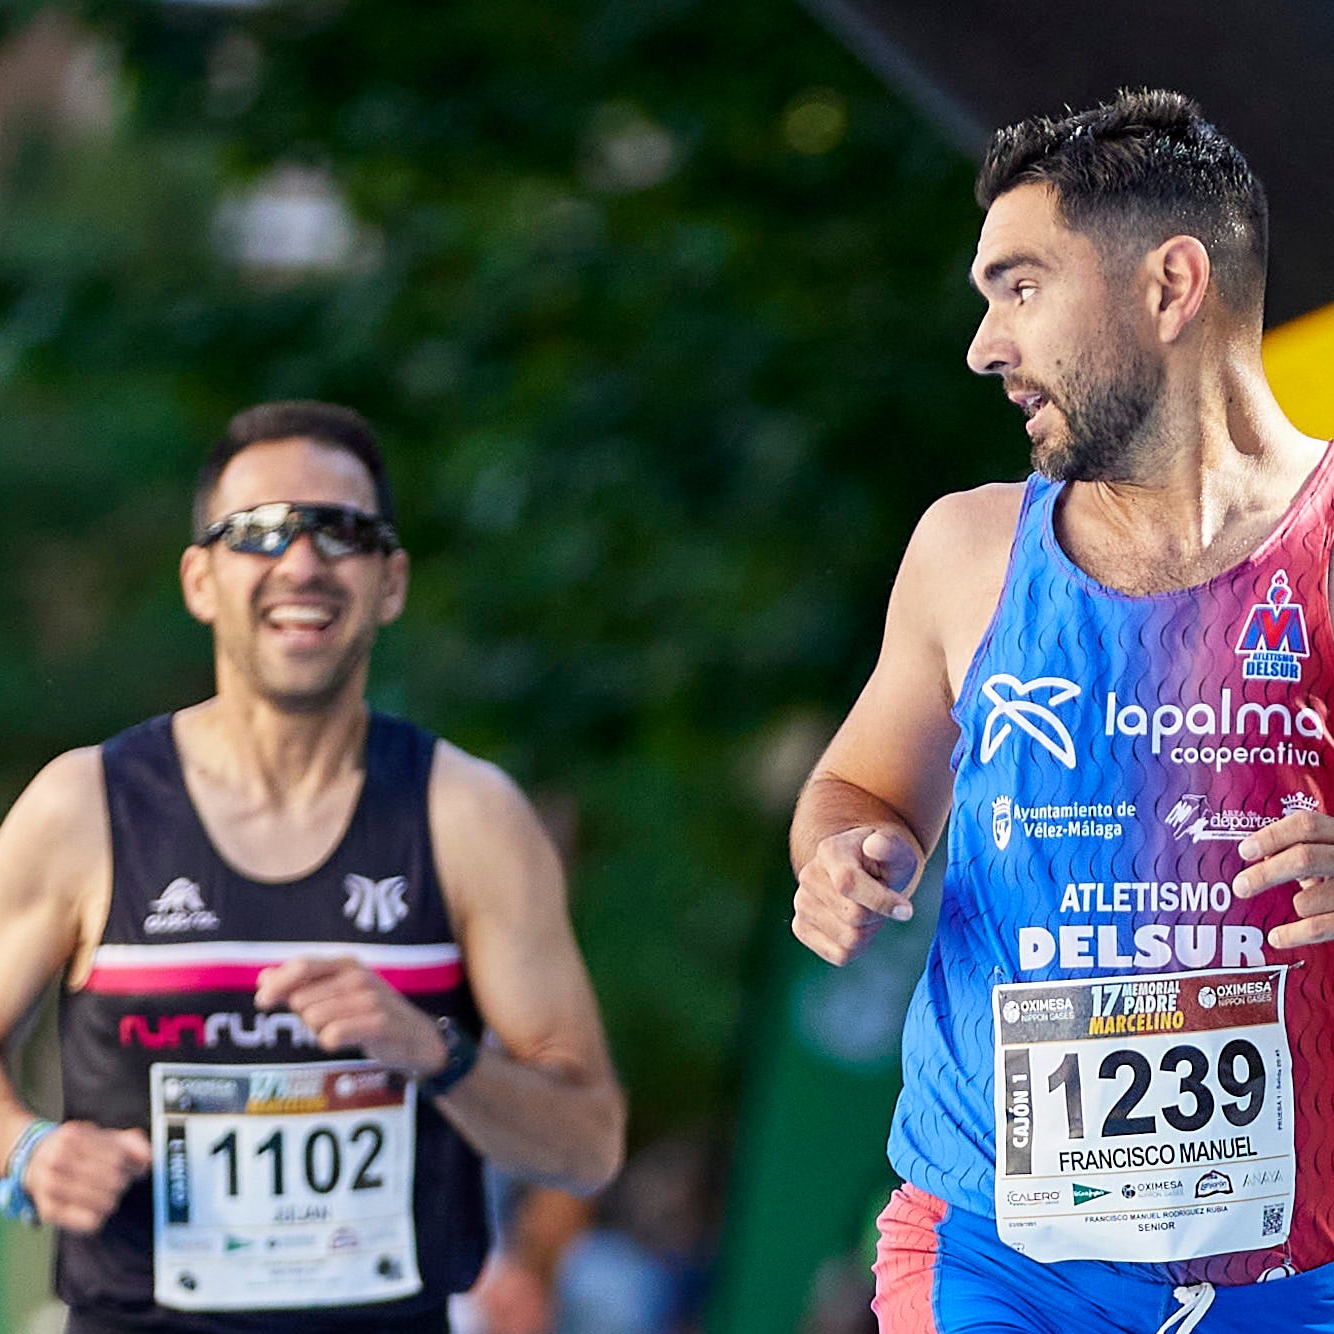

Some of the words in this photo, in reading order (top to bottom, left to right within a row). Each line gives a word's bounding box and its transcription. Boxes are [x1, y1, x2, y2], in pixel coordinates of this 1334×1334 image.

[1246, 661, 1299, 679] DELSUR
[1104, 688, 1324, 755] lapalma
[1170, 743, 1321, 773] cooperativa
[1014, 801, 1113, 820] Ayuntamiento
[1117, 800, 1136, 817] de
[1024, 820, 1122, 839] Vélez-Málaga
[1059, 881, 1231, 914] ATLETISMO
[1019, 924, 1266, 971] DELSUR
[1122, 981, 1180, 996] MEMORIAL
[1217, 982, 1272, 996] OXIMESA
[1020, 998, 1074, 1013] OXIMESA
[1090, 984, 1122, 1017] 17
[1124, 994, 1177, 1015] PADRE
[118, 1012, 320, 1051] runrun
[1088, 1010, 1185, 1036] MARCELINO
[1012, 1073, 1027, 1083] 1
[1048, 1038, 1267, 1140] 1239
[1009, 1090, 1030, 1148] CAJÓN
[210, 1121, 383, 1196] 1102
[1059, 1144, 1175, 1172] FRANCISCO
[1180, 1136, 1258, 1163] MANUEL
[1137, 1180, 1184, 1191] OXIMESA
[1242, 1170, 1284, 1188] ANAYA
[1010, 1191, 1060, 1202] CALERO
[1084, 1213, 1129, 1223] FRANCISCO
[1130, 1211, 1161, 1220] MANUEL
[1138, 1220, 1176, 1232] SENIOR
